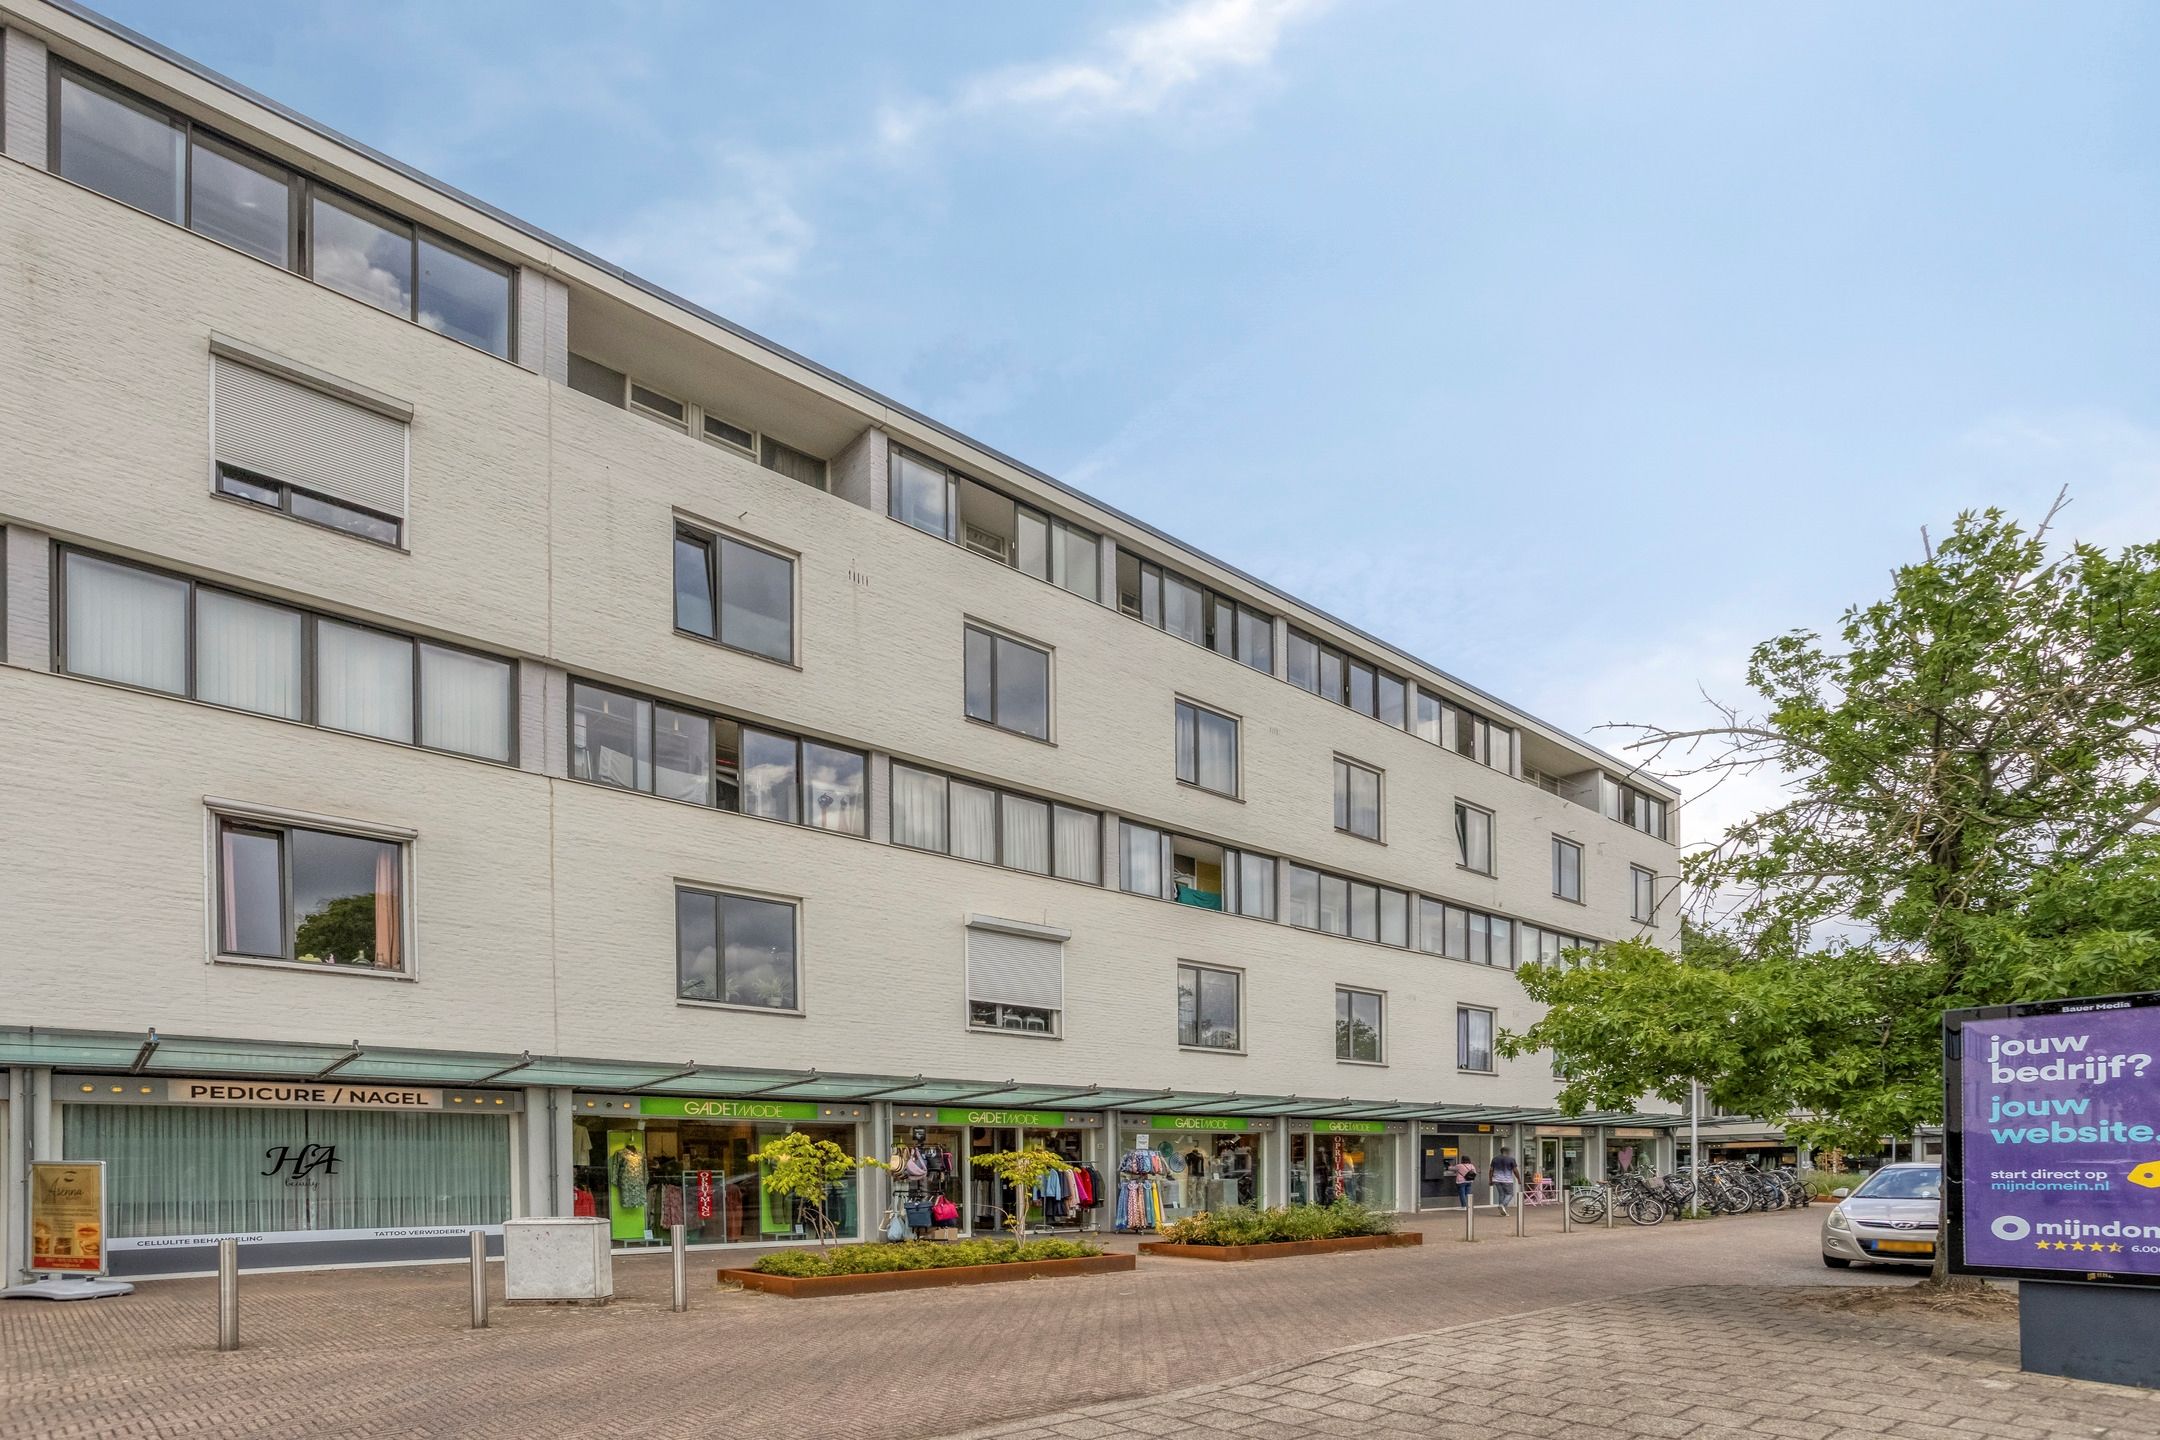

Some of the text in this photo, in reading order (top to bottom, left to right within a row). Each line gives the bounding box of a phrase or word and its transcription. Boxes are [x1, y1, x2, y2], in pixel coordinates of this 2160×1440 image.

[2061, 1001, 2131, 1013] Bauer Media
[1987, 1035, 2090, 1063] jouw
[1991, 1053, 2152, 1085] bedrijf?
[190, 1085, 326, 1102] PEDICURE
[350, 1090, 429, 1105] NAGEL
[1988, 1095, 2090, 1123] jouw
[1991, 1169, 2108, 1181] start direct op
[1991, 1180, 2110, 1193] mijndomein.nl
[136, 1235, 263, 1247] CELLULITE BEHAELING
[2131, 1245, 2160, 1254] 6.00
